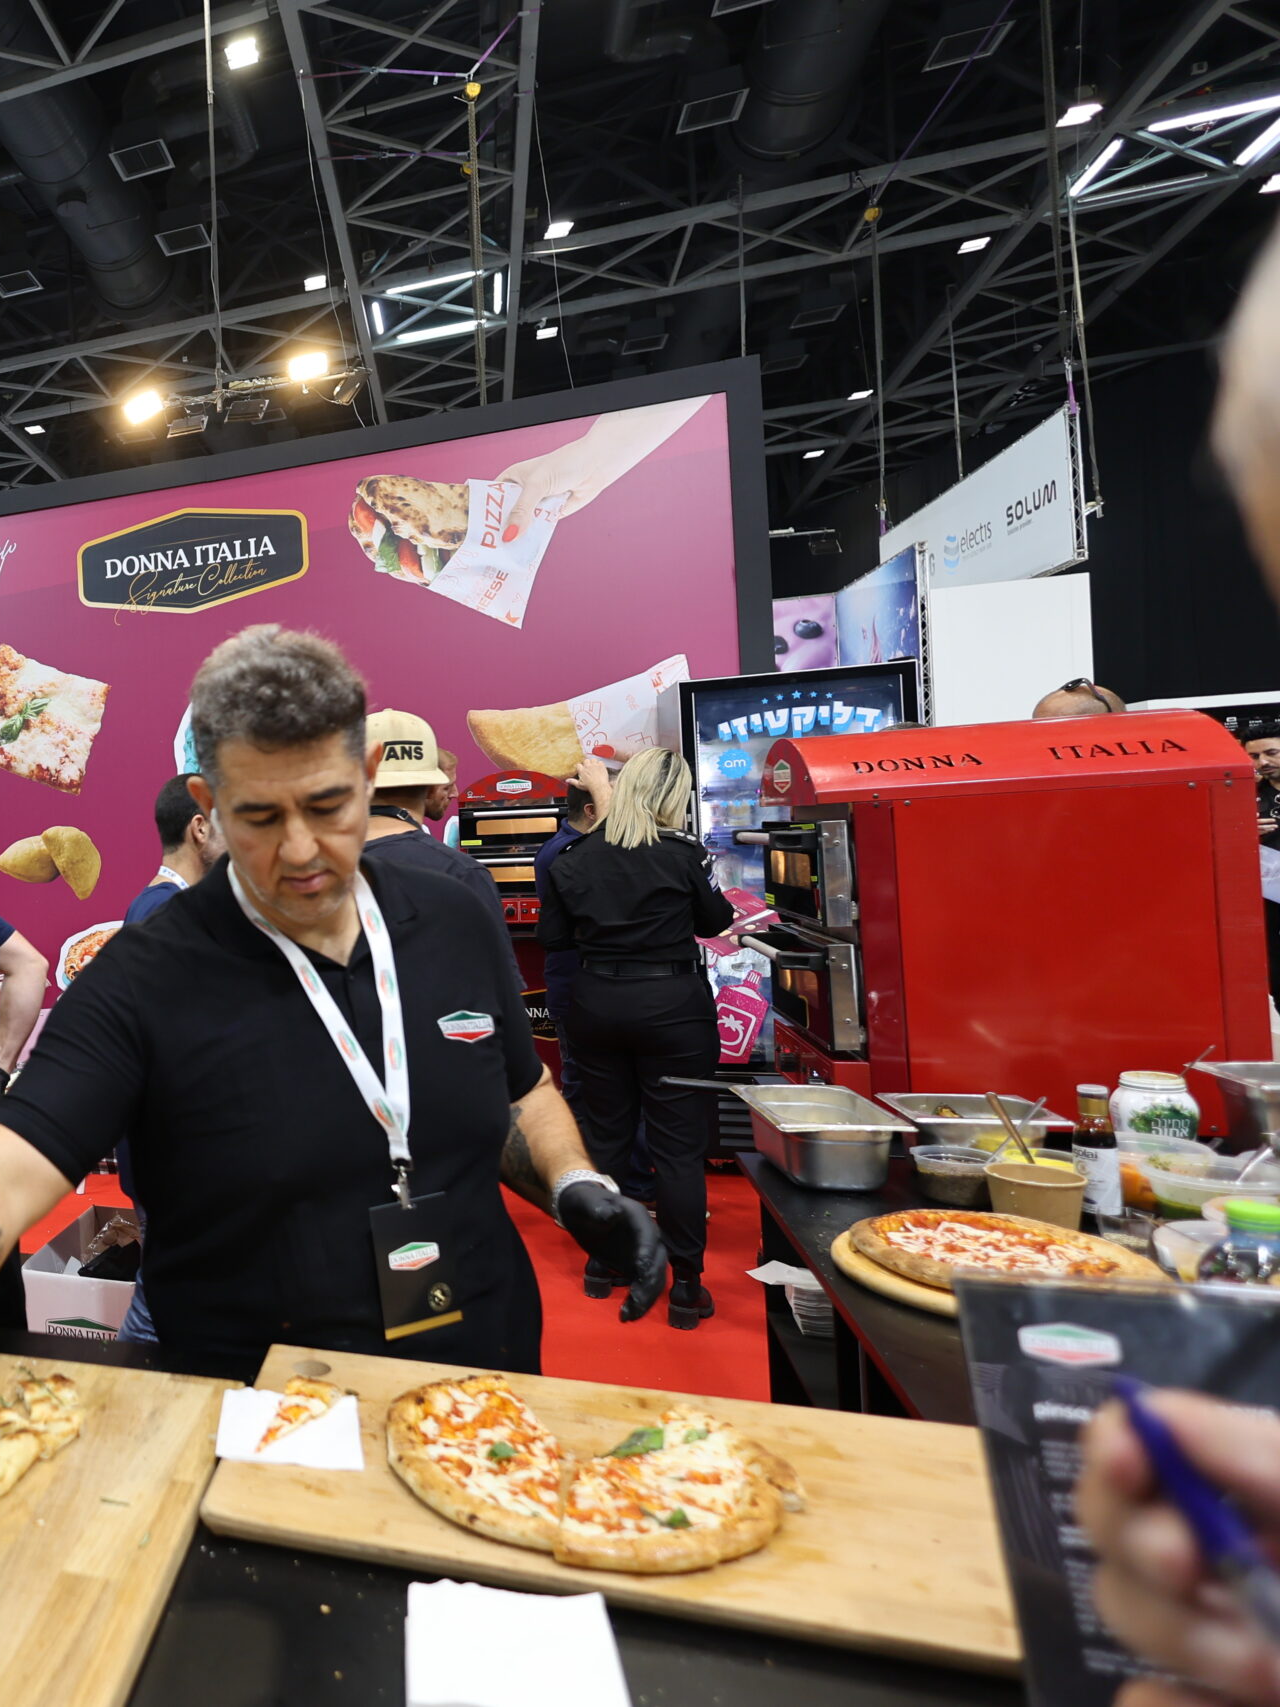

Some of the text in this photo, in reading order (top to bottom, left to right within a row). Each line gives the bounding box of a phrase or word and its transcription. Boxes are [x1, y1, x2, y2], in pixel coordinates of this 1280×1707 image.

[480, 482, 506, 549] PIZZA
[1006, 479, 1057, 527] SOLUM
[960, 521, 992, 554] electis
[104, 535, 277, 579] DONNA ITALIA
[114, 559, 267, 626] Signature Collection
[716, 700, 883, 744] דליקטיזי
[723, 757, 747, 769] am
[851, 737, 1189, 775] DONNA ITALIA
[525, 1007, 550, 1018] NNA
[1151, 1117, 1191, 1128] טחינה
[47, 1324, 84, 1339] DONNA
